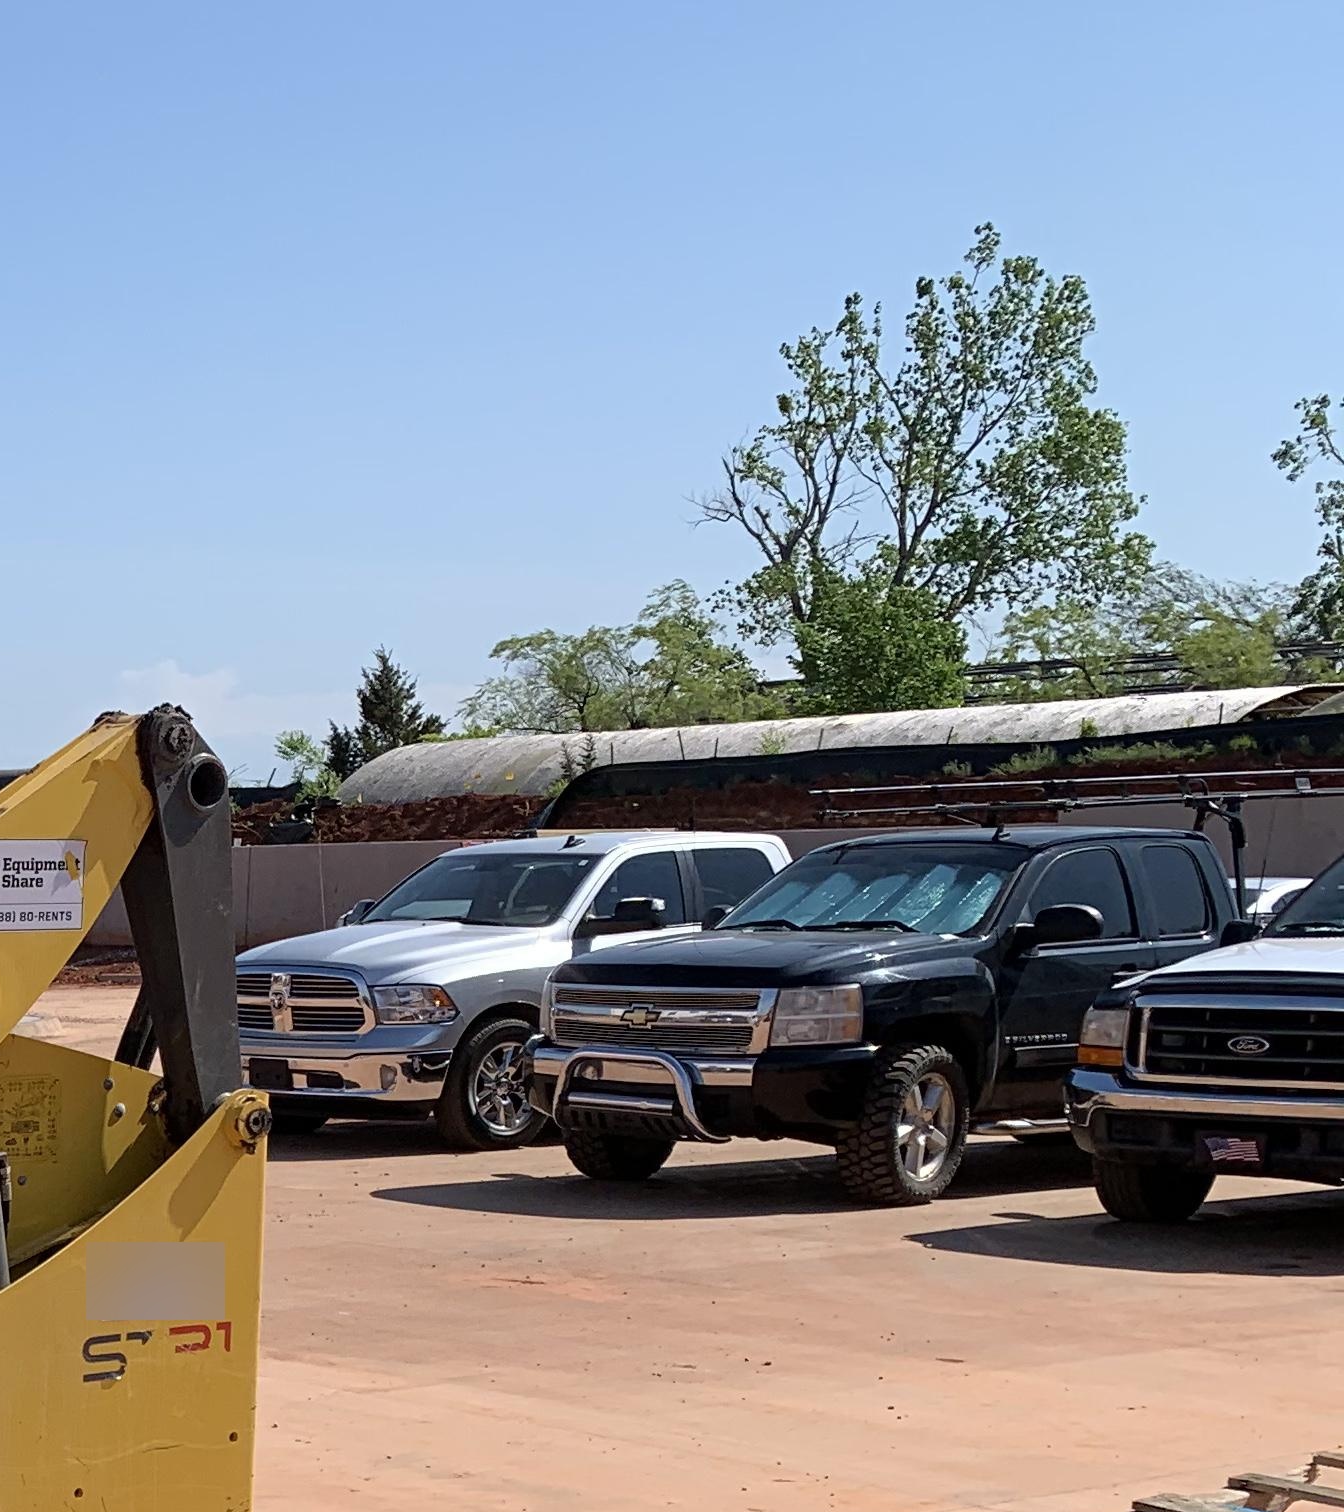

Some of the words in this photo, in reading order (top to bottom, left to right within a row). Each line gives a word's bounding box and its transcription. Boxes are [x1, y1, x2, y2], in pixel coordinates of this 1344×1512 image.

[2, 857, 81, 875] Equipmet
[1, 874, 44, 889] Share
[19, 911, 73, 922] 80-RENTS
